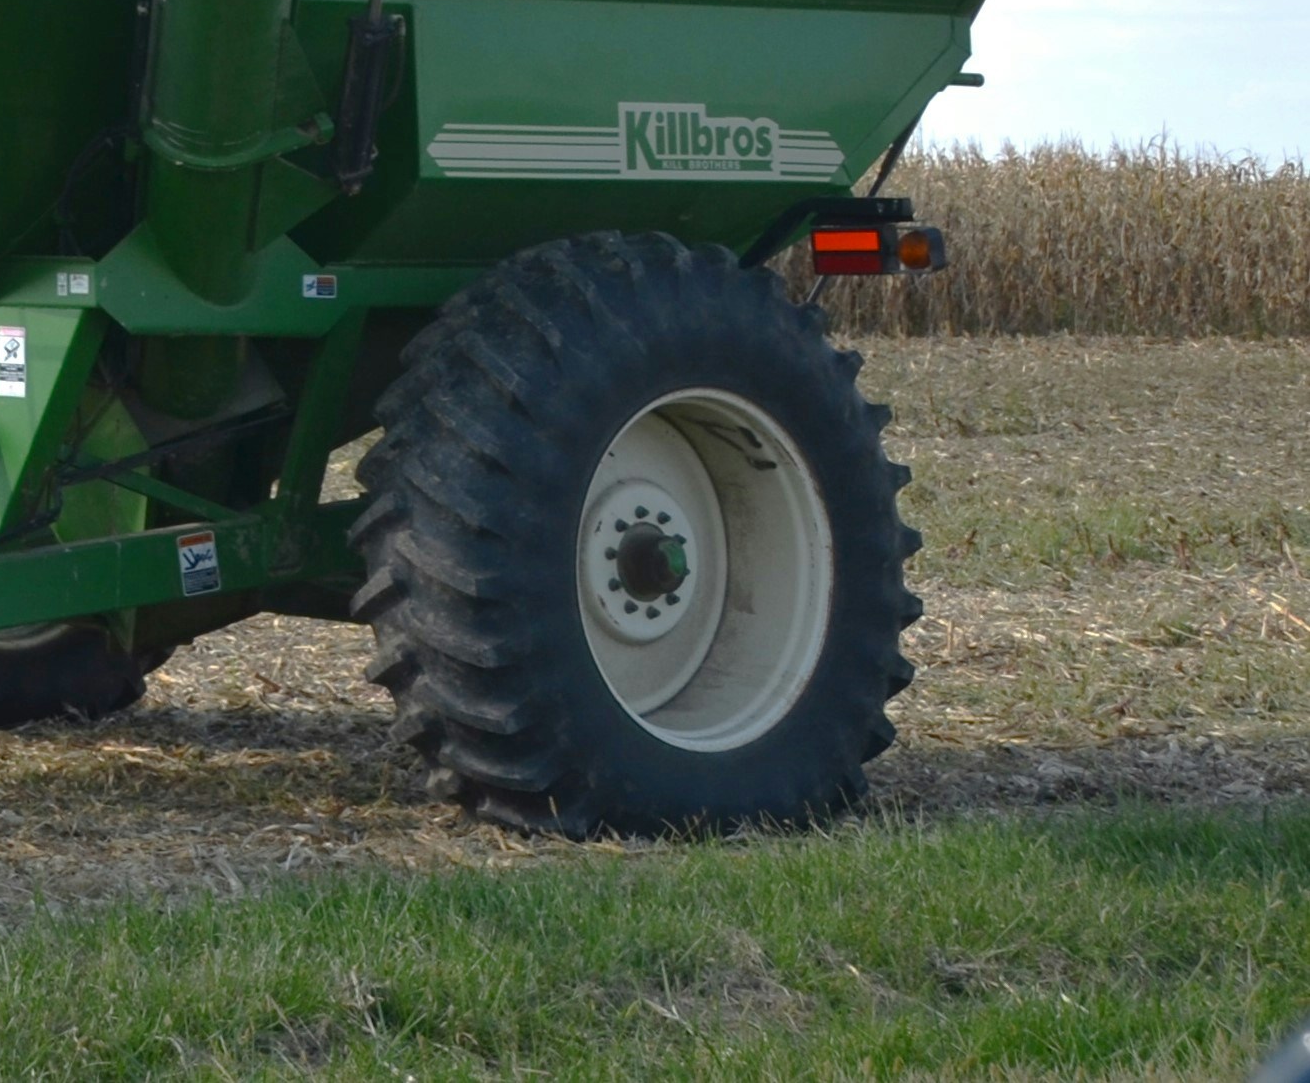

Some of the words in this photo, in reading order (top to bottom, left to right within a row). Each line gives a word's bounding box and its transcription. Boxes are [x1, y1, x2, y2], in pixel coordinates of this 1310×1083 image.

[625, 111, 773, 171] Killbros
[662, 160, 683, 170] KILL
[689, 160, 741, 170] BROTHERS
